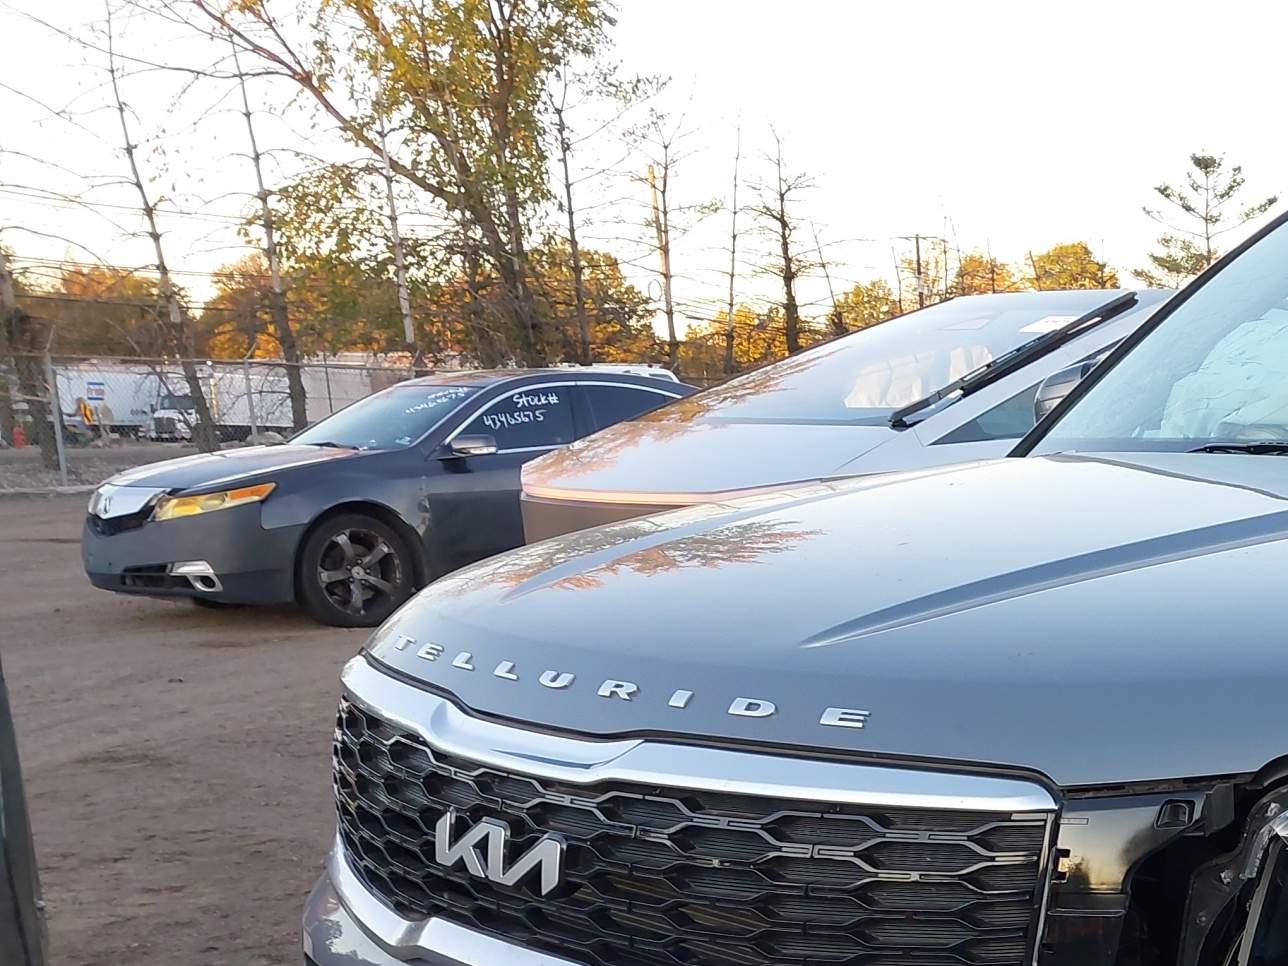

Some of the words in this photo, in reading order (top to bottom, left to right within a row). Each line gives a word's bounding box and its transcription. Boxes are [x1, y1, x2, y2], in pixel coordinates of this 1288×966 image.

[483, 409, 547, 430] 43465675
[513, 393, 560, 408] Stock#
[392, 635, 872, 730] TELLURIDE
[434, 806, 568, 897] KIA
